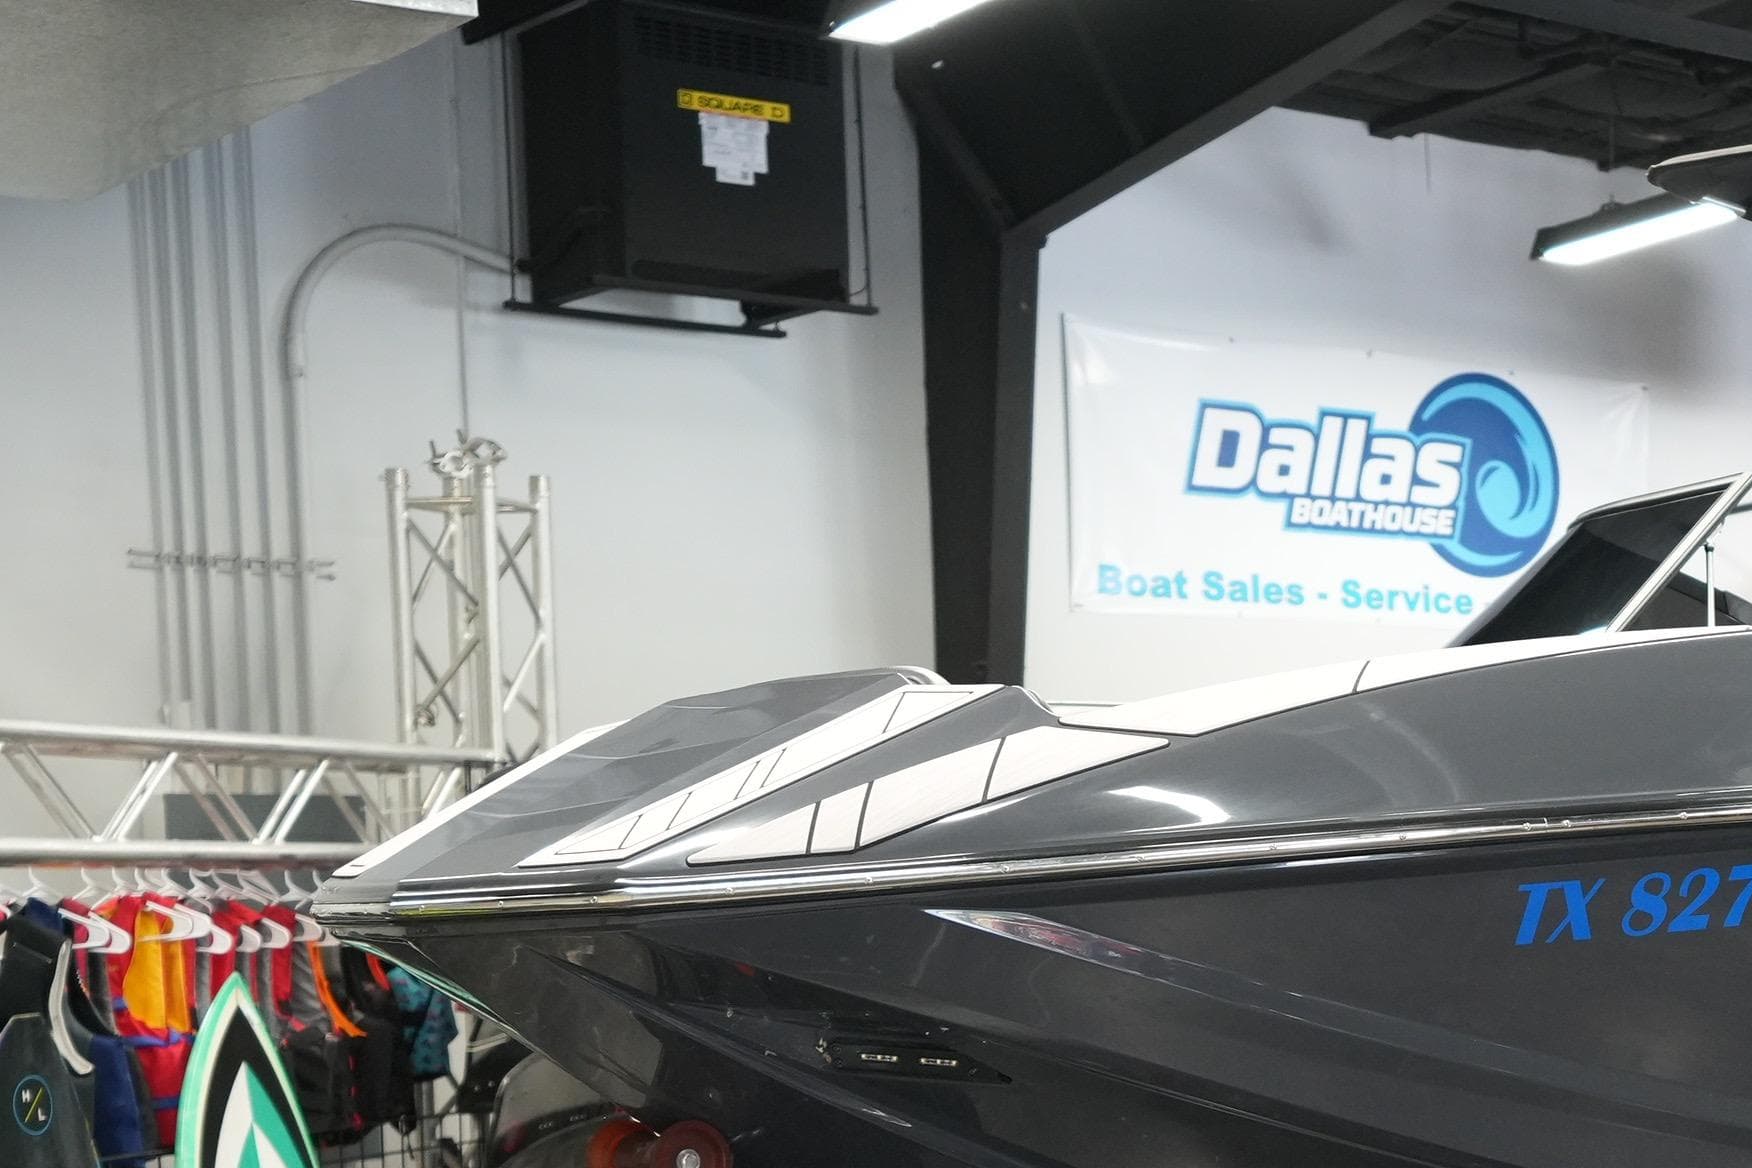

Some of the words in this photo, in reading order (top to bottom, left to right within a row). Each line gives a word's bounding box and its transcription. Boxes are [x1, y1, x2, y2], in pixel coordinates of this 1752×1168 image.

[697, 96, 764, 116] SQUARE
[1190, 405, 1464, 508] Dallas
[1289, 498, 1456, 536] BOATHOUSE
[1097, 564, 1188, 600] Boat
[1202, 570, 1306, 605] Sales
[1341, 580, 1473, 615] Service
[1515, 879, 1605, 946] TX
